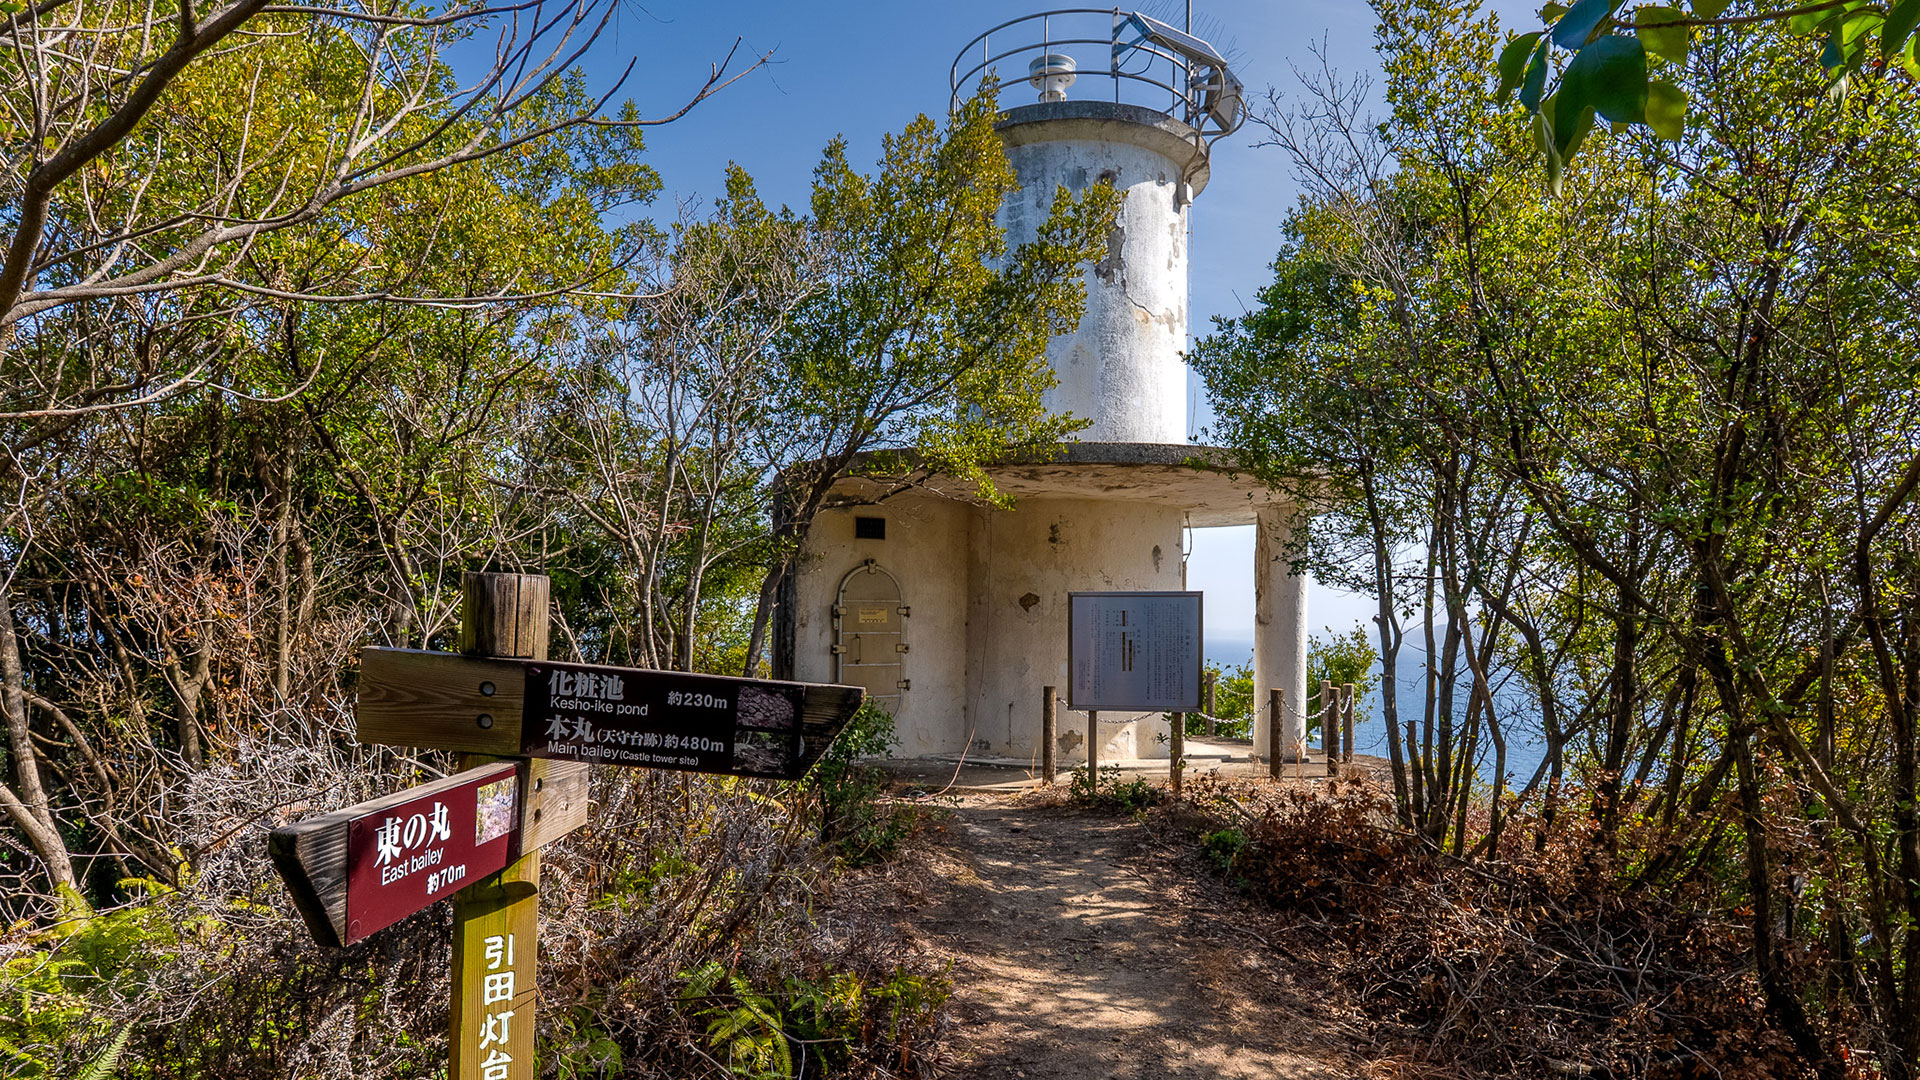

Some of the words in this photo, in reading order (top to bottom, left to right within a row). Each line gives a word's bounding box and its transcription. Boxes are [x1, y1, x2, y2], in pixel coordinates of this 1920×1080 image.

[548, 669, 624, 701] 化粧池
[667, 690, 728, 709] 約230m
[550, 695, 613, 713] Kesho-ike
[616, 703, 648, 716] pond
[547, 741, 578, 755] Main
[652, 754, 677, 764] tower
[678, 756, 699, 766] site)
[373, 801, 451, 869] 東の丸
[381, 859, 409, 886] East
[410, 847, 444, 874] bailey
[426, 864, 466, 895] 約70m
[479, 933, 515, 1080] 引田灯台
